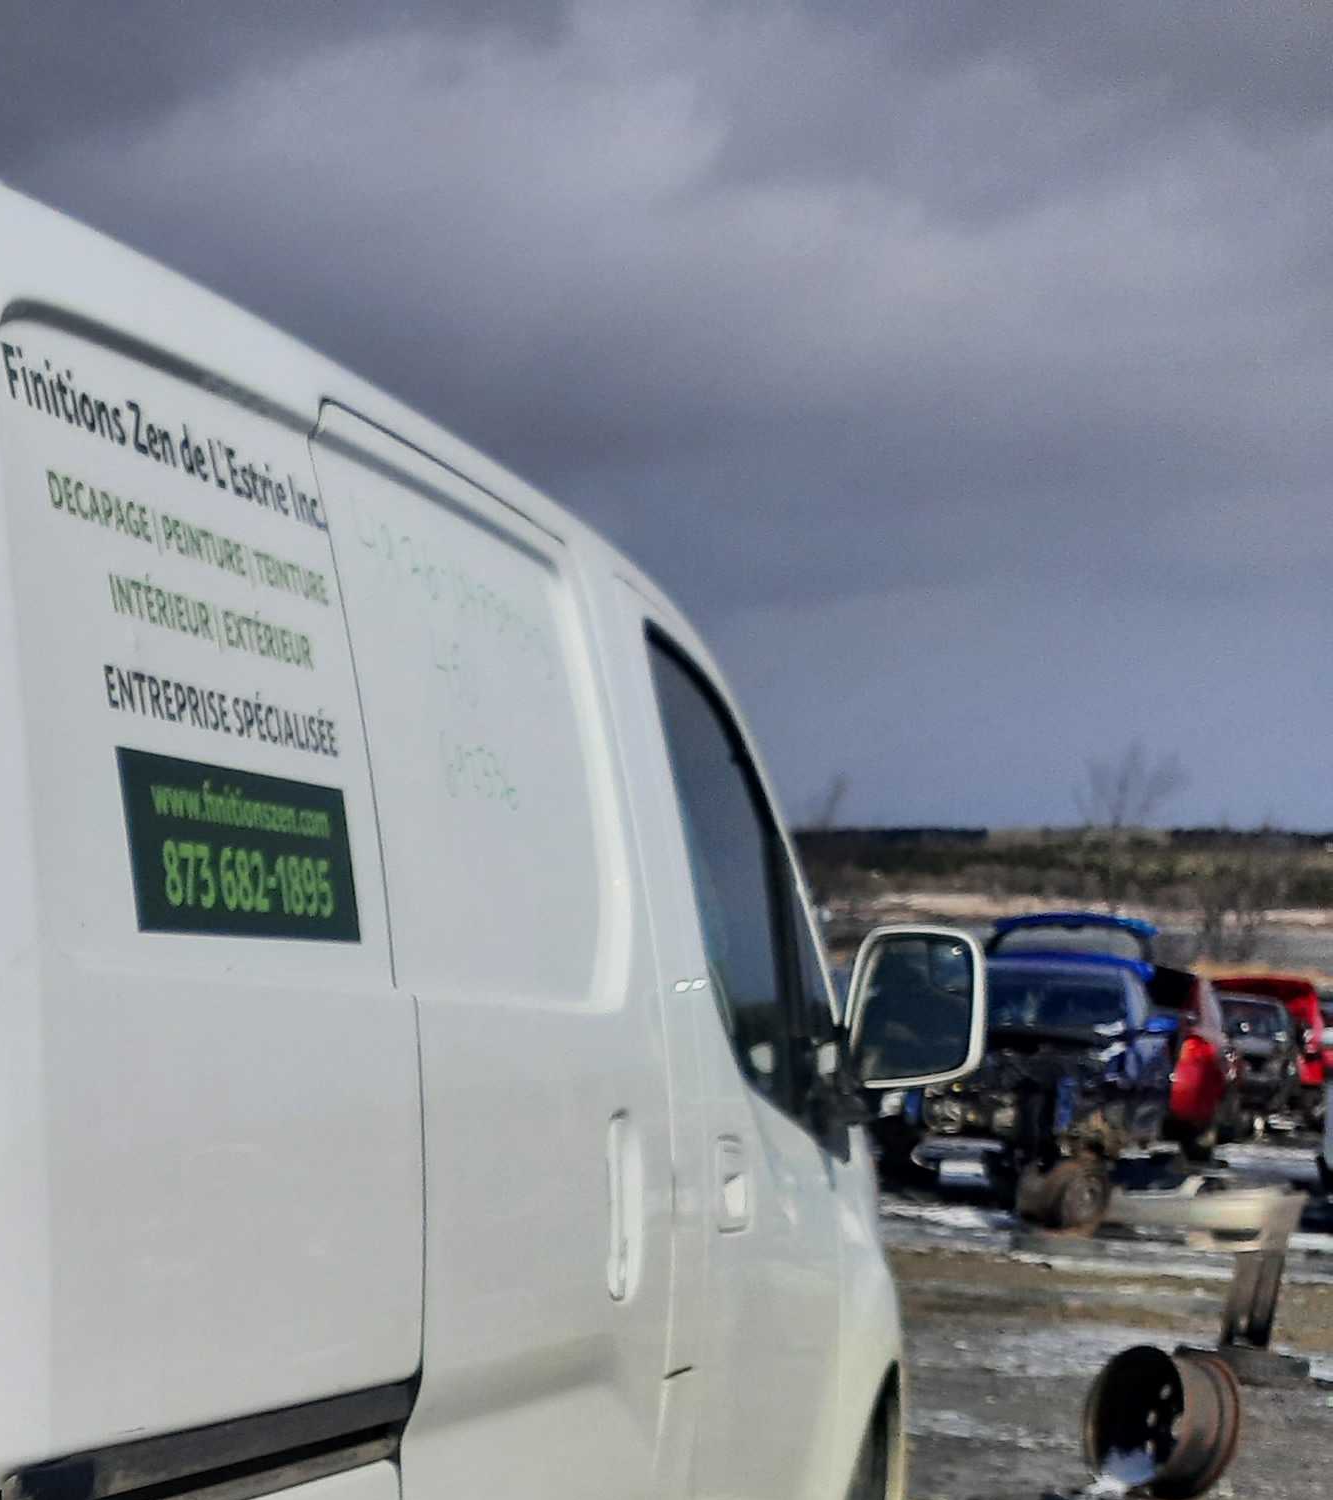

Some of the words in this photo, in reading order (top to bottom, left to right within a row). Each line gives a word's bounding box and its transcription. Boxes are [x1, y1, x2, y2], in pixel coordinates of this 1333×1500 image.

[0, 341, 126, 447] Finitions
[126, 400, 177, 469] Zen
[179, 423, 209, 483] de
[160, 514, 247, 577] PEINTURE
[108, 571, 215, 642] INTÉRIEUR
[102, 664, 233, 734] ENTREPRISE
[232, 691, 340, 757] SPÉCIALISÉE
[163, 839, 216, 910] 873
[220, 847, 334, 918] 682-1895
